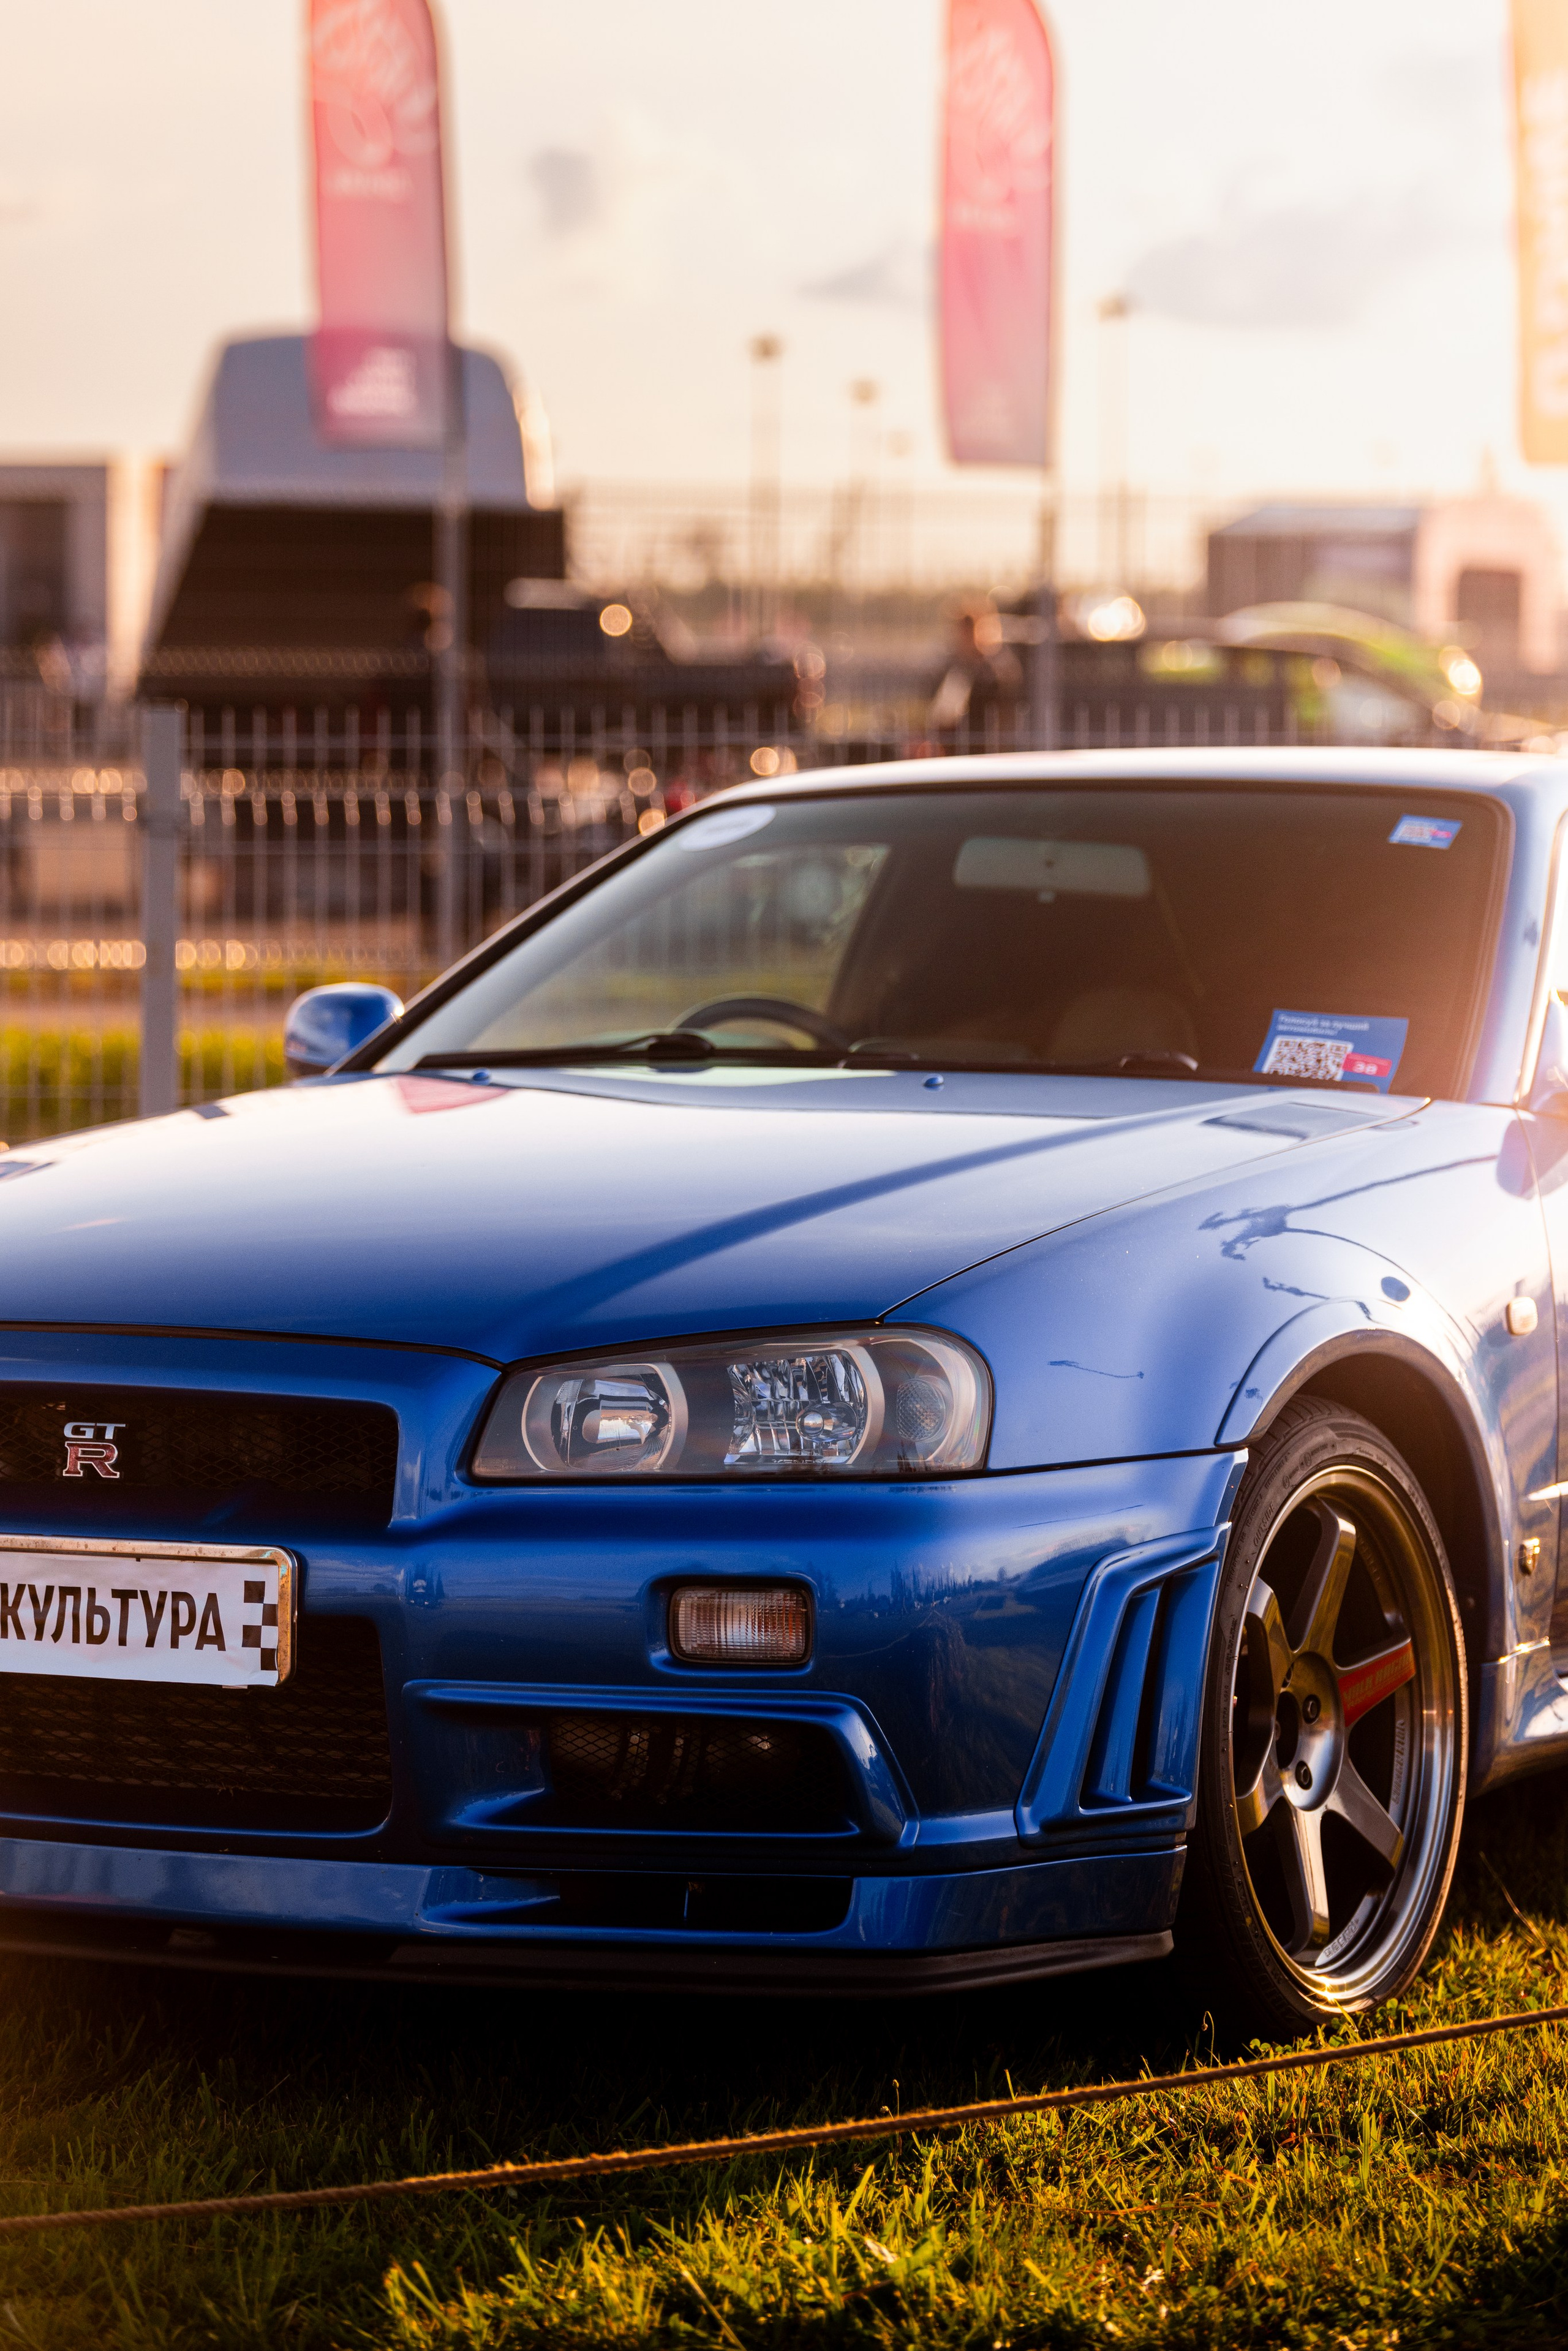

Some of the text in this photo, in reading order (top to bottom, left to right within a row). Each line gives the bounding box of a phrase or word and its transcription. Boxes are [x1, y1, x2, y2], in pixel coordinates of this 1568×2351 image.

[63, 1422, 126, 1440] GT
[62, 1441, 120, 1478] R
[1254, 1503, 1275, 1547] OUTSIDE
[0, 1583, 226, 1651] КУЛЬТУРА
